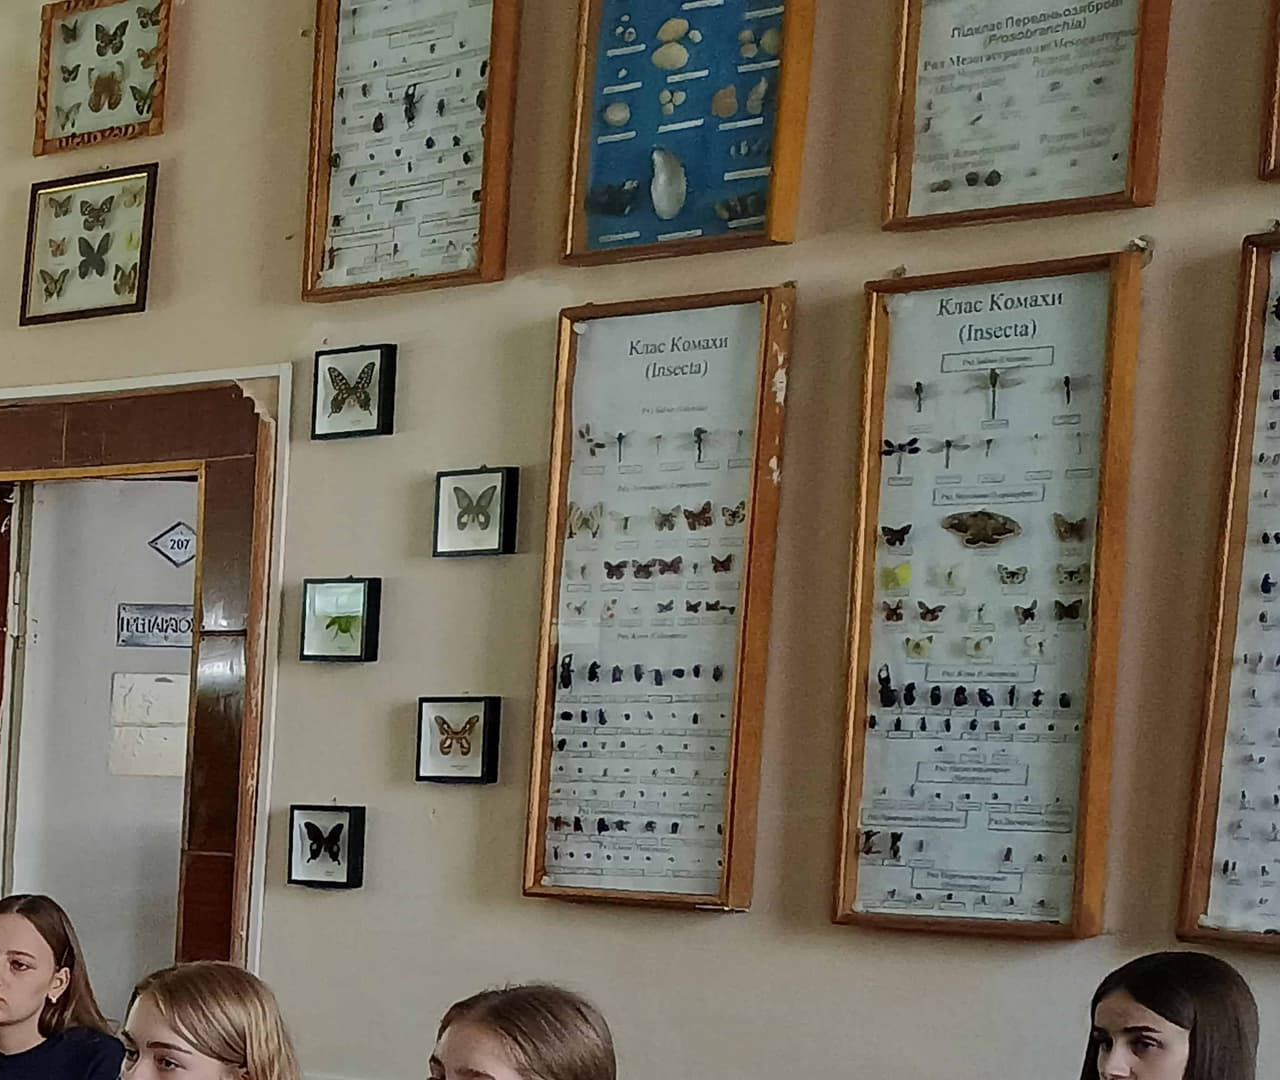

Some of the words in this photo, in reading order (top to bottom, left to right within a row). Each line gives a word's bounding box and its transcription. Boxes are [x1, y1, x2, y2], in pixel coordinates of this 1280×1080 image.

[936, 298, 983, 317] Клас
[989, 291, 1063, 312] Комахи
[958, 319, 1038, 344] (Insecta)
[628, 339, 666, 356] Клас
[670, 335, 729, 353] Комахи
[644, 360, 709, 380] (Insecta)
[169, 538, 191, 551] 207
